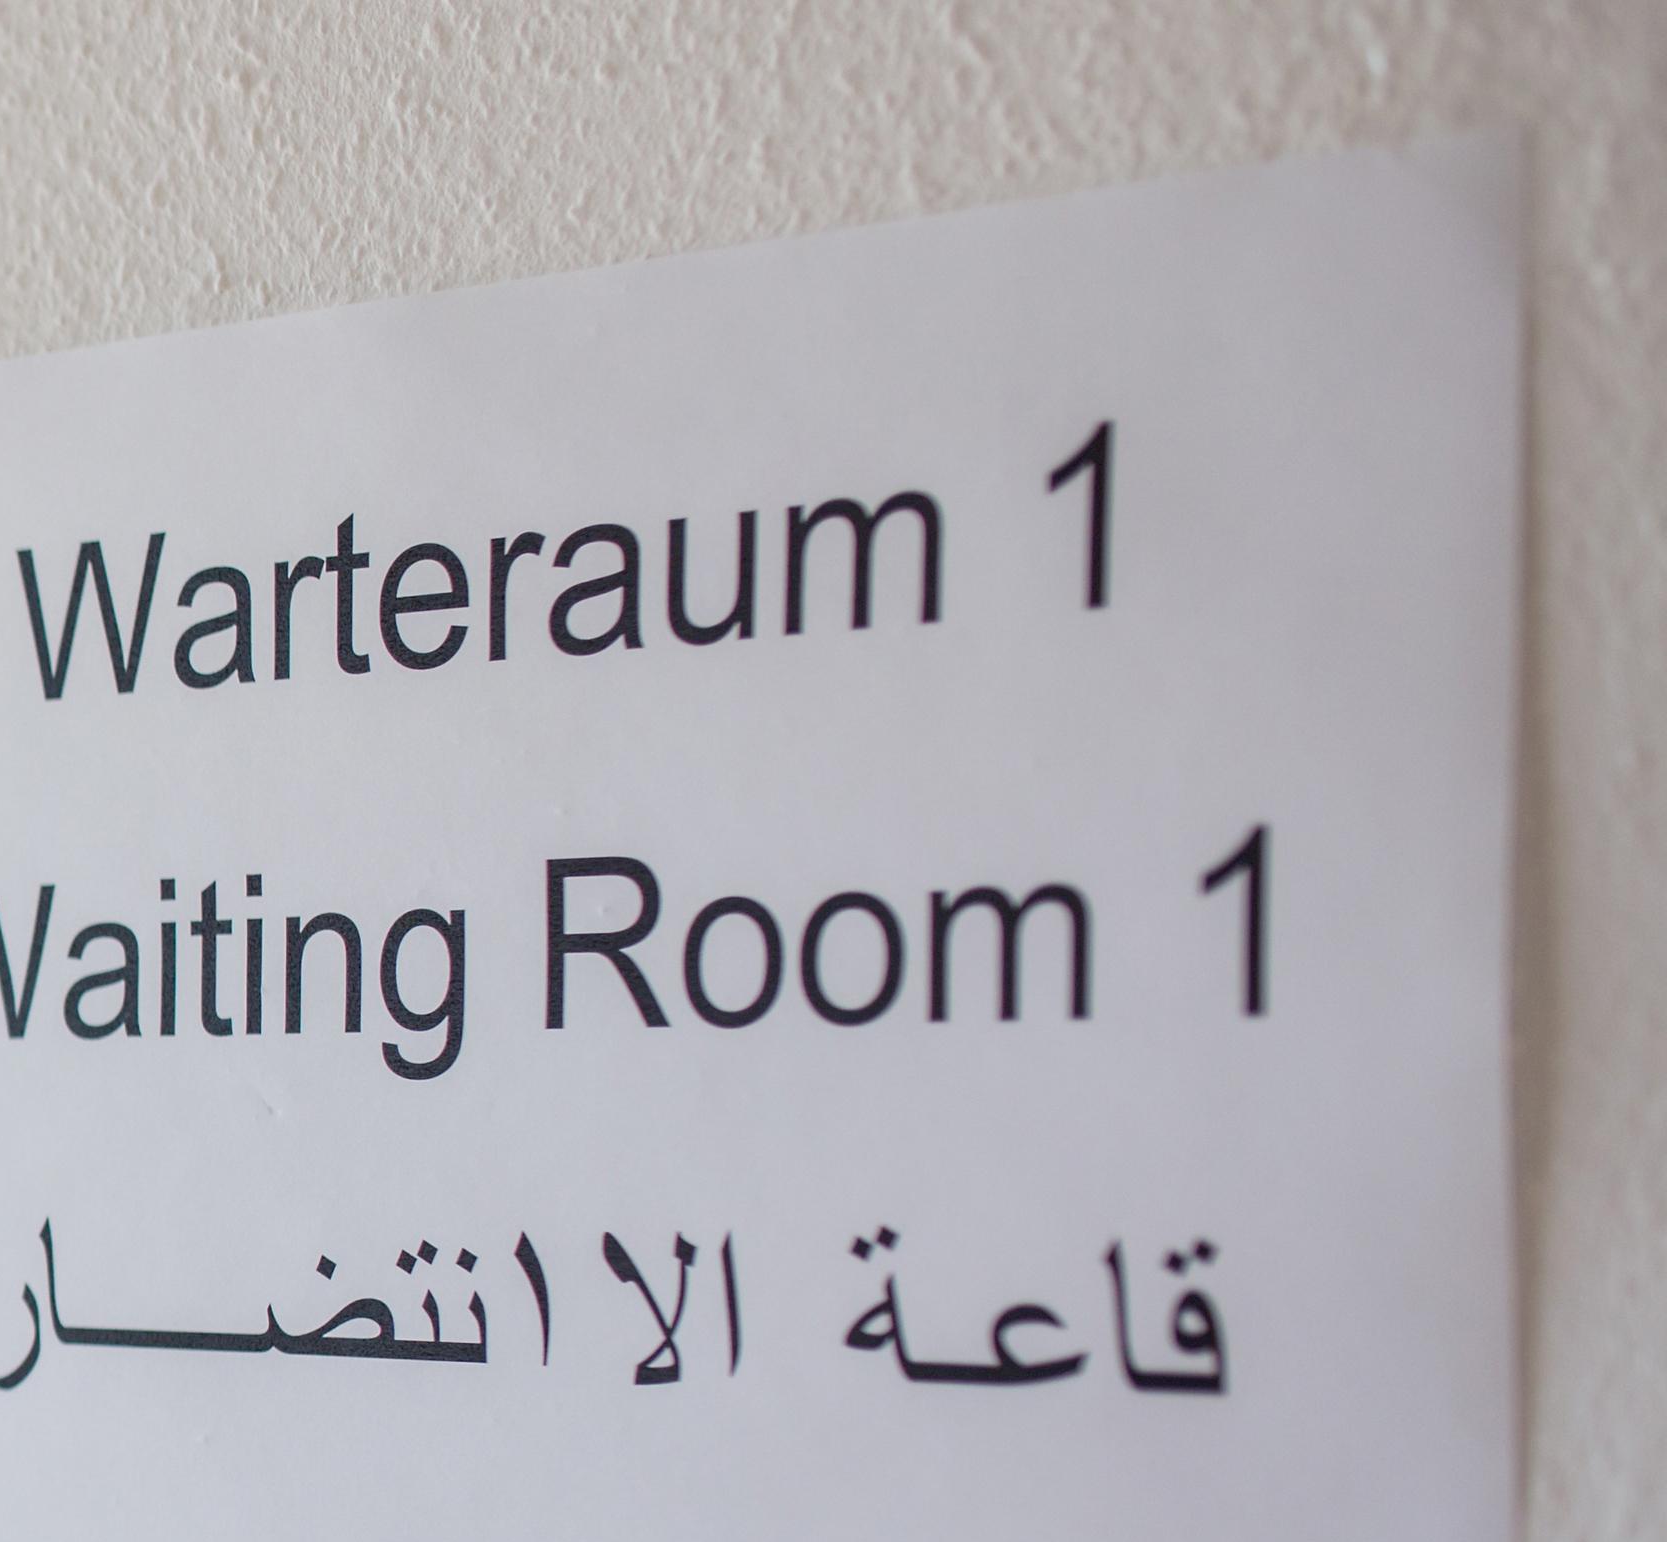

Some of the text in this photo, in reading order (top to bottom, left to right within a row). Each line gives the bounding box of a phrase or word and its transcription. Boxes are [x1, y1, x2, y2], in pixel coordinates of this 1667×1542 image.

[16, 419, 1115, 701] Warteraum 1
[544, 855, 1093, 1031] Room
[1199, 823, 1270, 1020] 1
